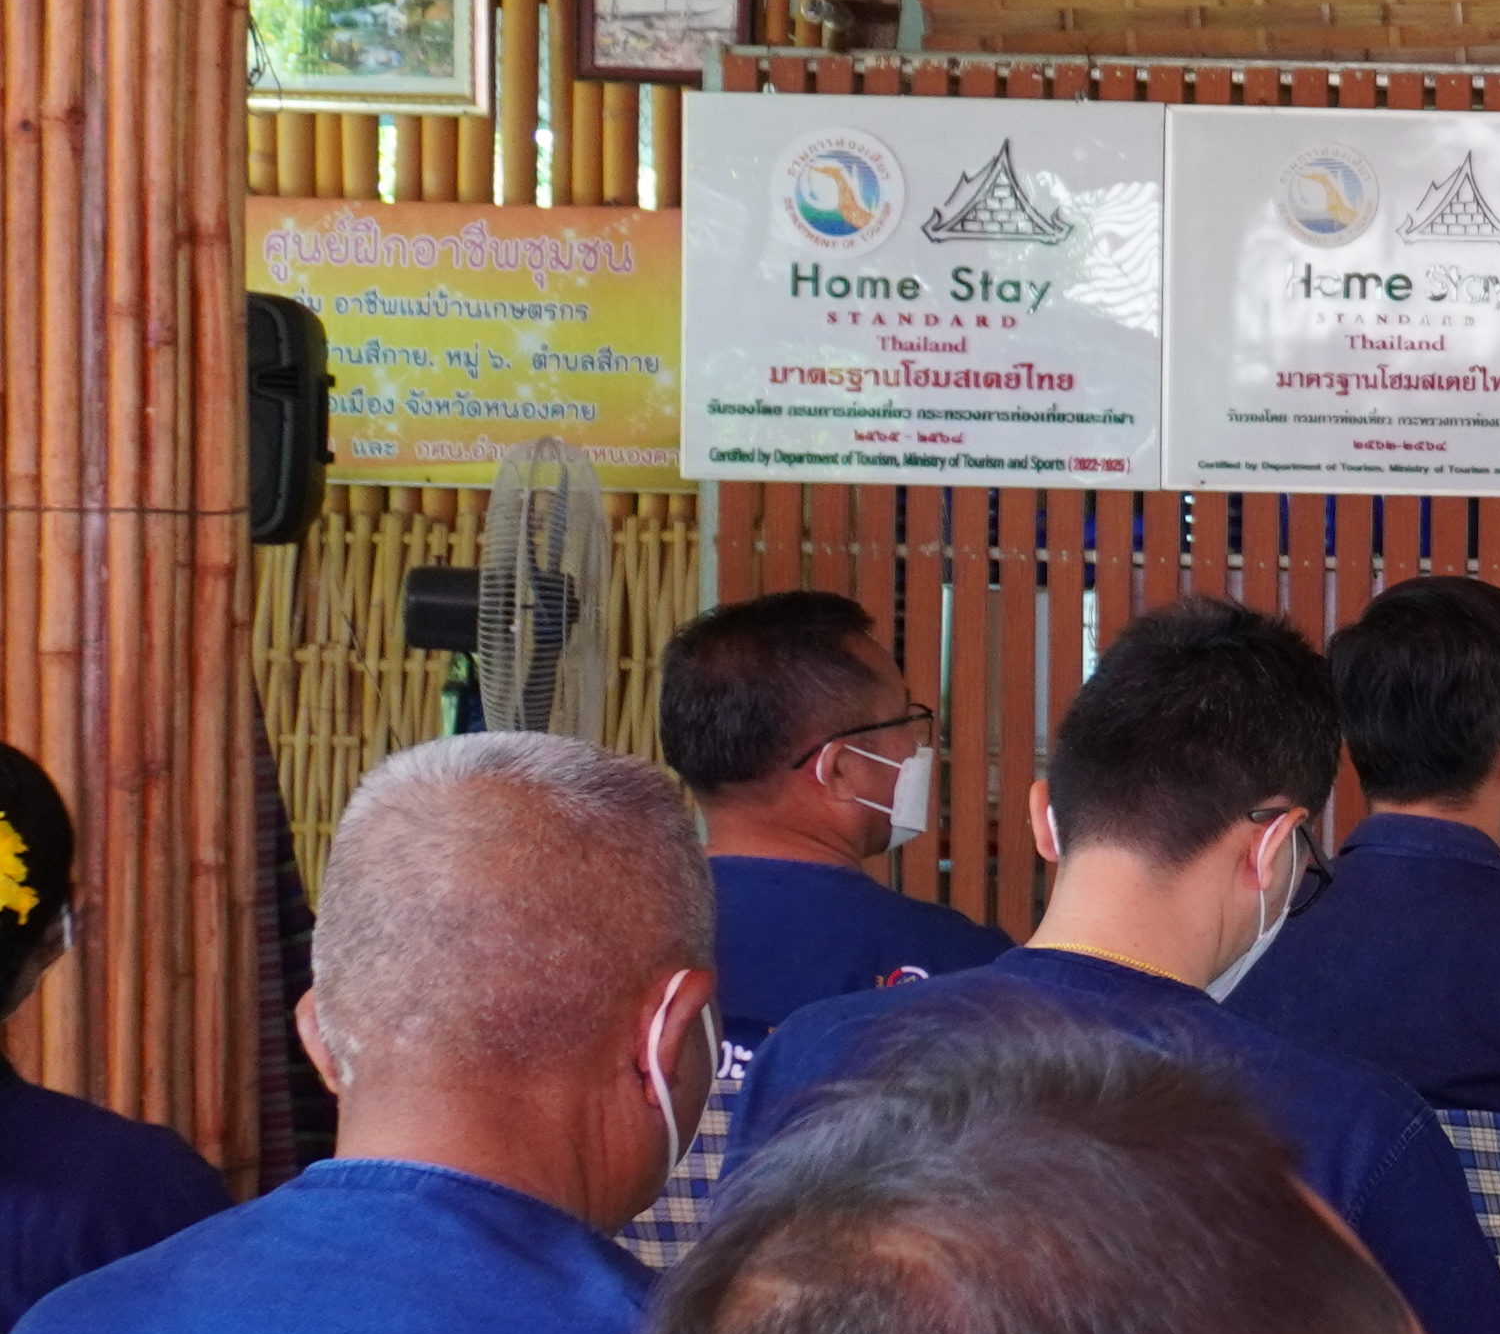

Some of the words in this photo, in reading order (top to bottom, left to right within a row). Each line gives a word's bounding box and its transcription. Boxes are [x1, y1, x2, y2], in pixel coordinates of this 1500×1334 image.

[264, 214, 634, 290] ศูนย์ฝึกอาชีพชุมชน
[790, 262, 921, 302] Home
[950, 266, 1051, 315] Stay
[1286, 261, 1413, 301] Home
[335, 289, 589, 322] อาชีพแม่บ้านเกษตรกร
[827, 310, 1019, 329] STANDARD
[1316, 312, 1475, 327] STANDARD
[877, 335, 968, 354] Thailand
[1345, 334, 1446, 352] Thailand
[532, 344, 660, 375] ตำบลสีกาย
[769, 360, 1075, 394] มาตรฐานโฮมสเตย์ไทย
[406, 389, 597, 421] จังหวัดหนองคาย
